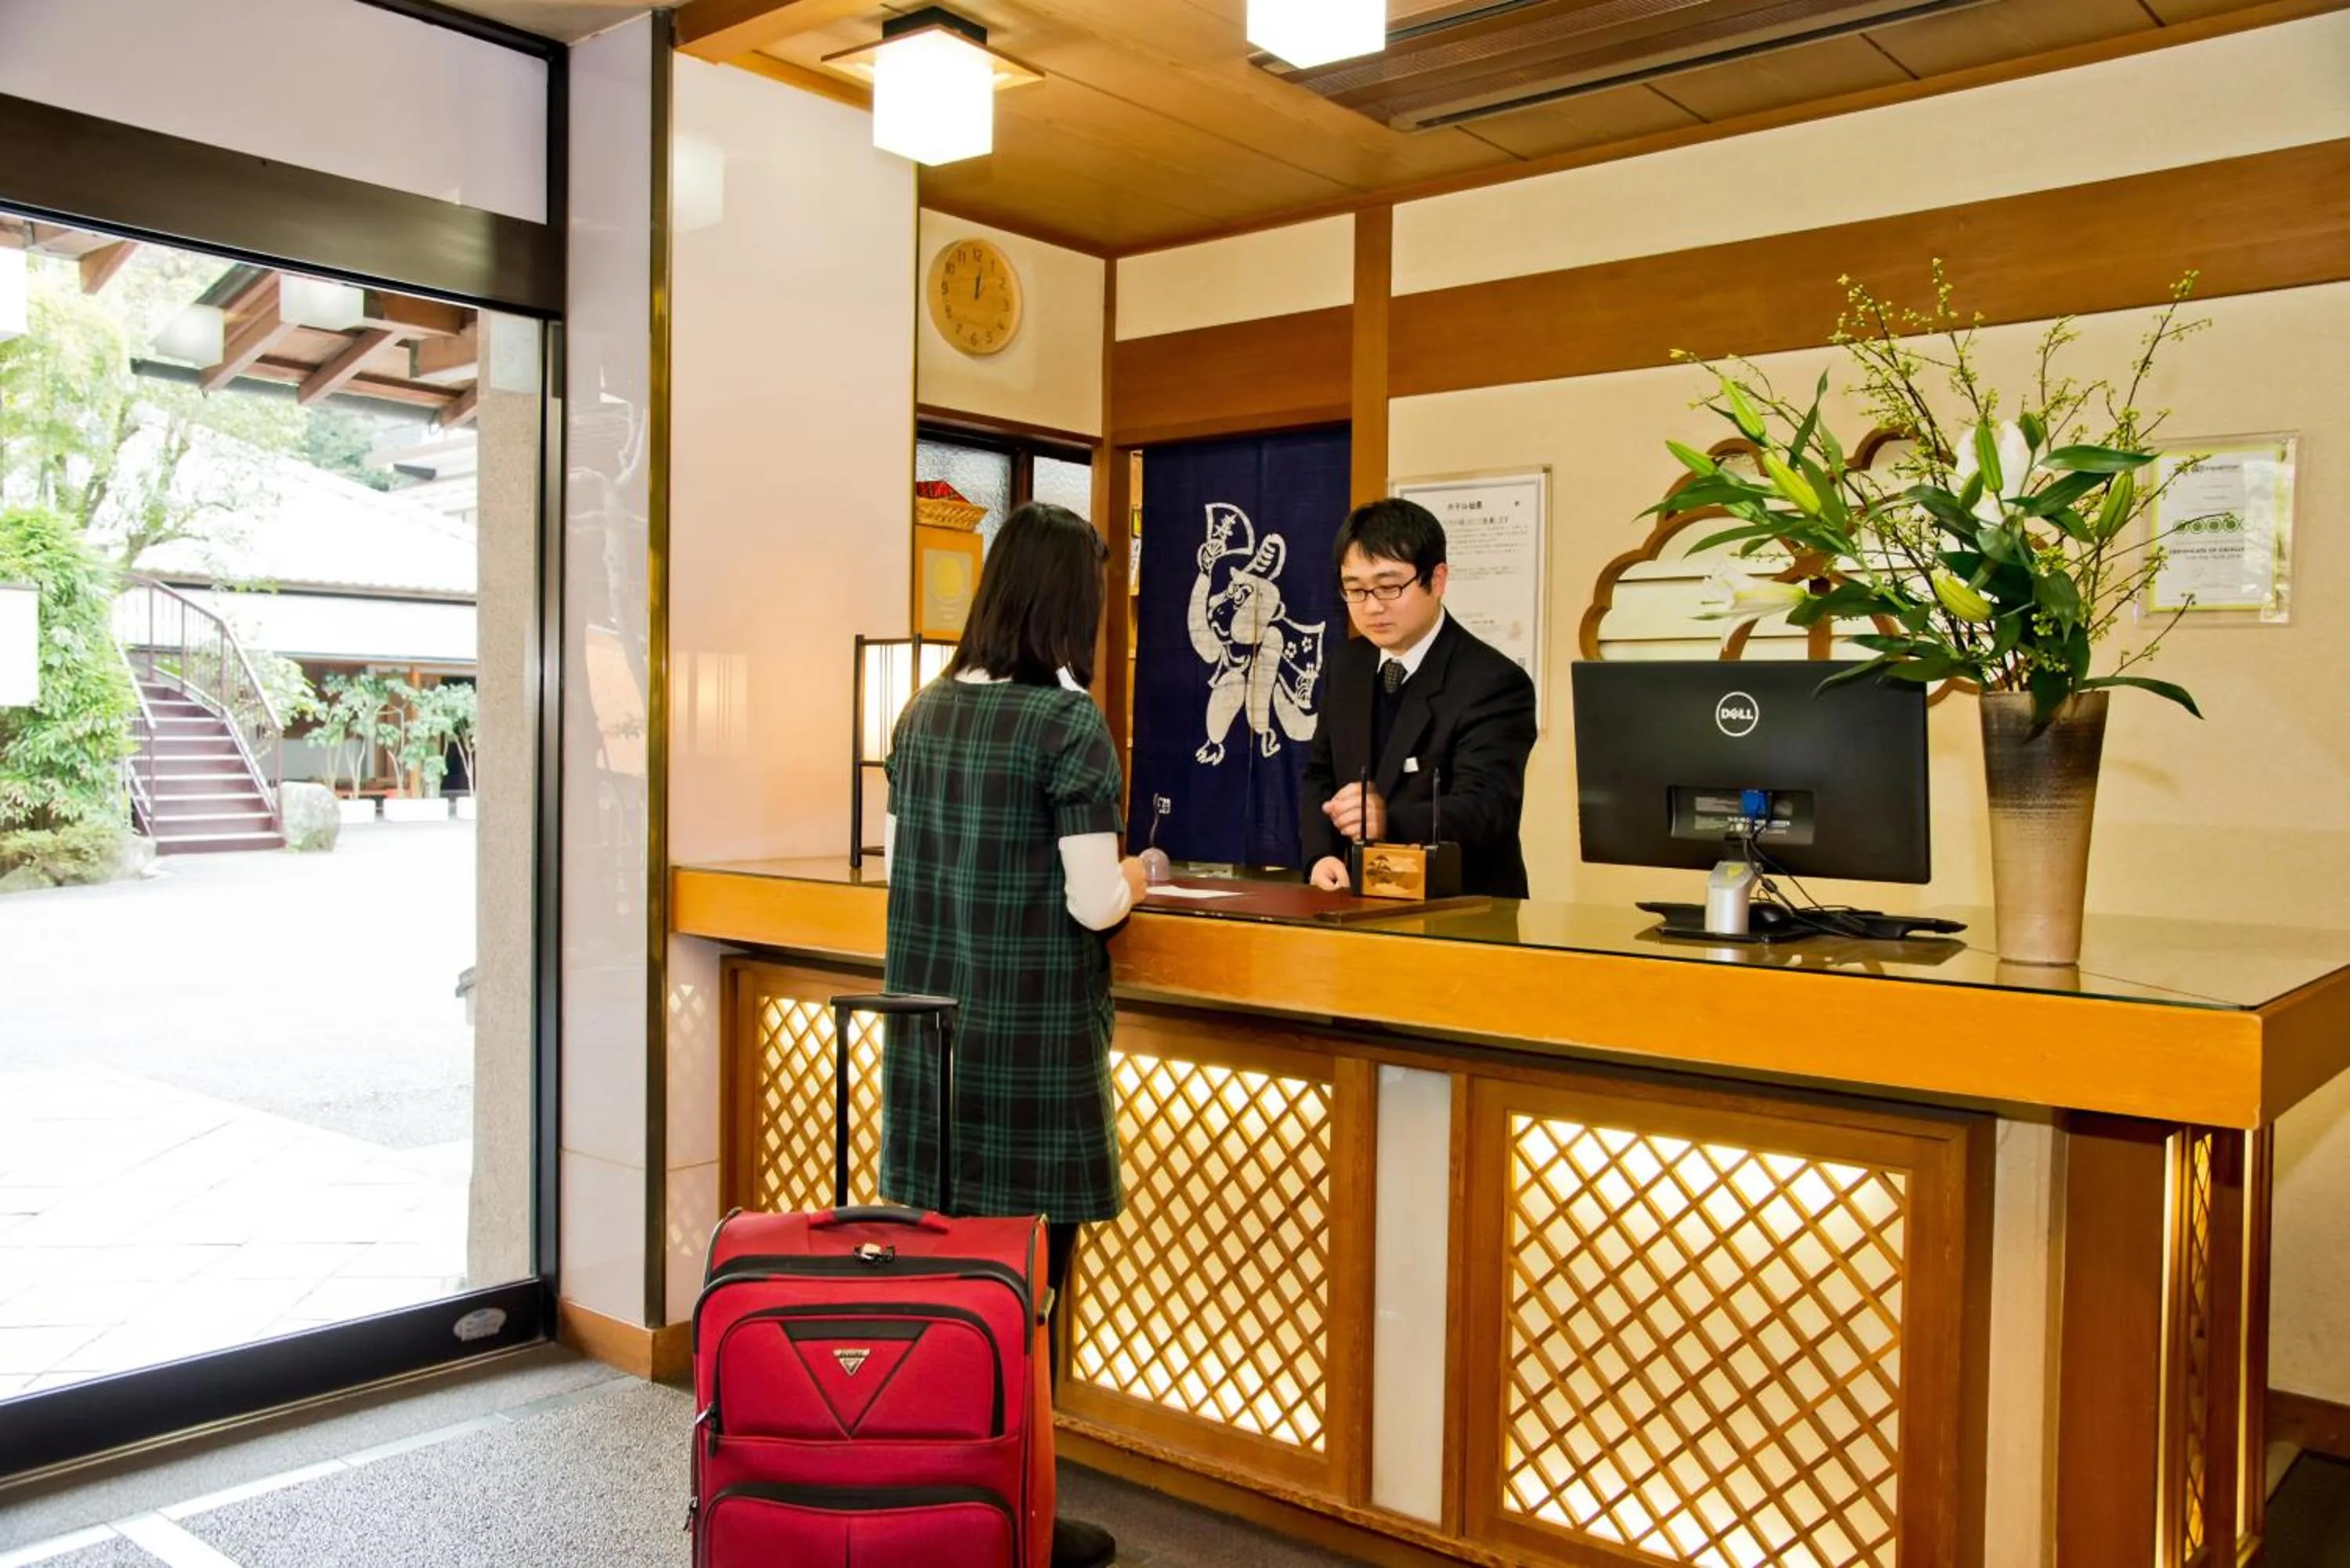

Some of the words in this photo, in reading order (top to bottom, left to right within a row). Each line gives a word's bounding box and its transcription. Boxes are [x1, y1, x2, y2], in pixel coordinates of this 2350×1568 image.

[957, 250, 966, 264] 11
[972, 248, 982, 262] 12
[945, 261, 955, 275] 10
[970, 332, 978, 346] 6
[1721, 707, 1754, 720] DELL
